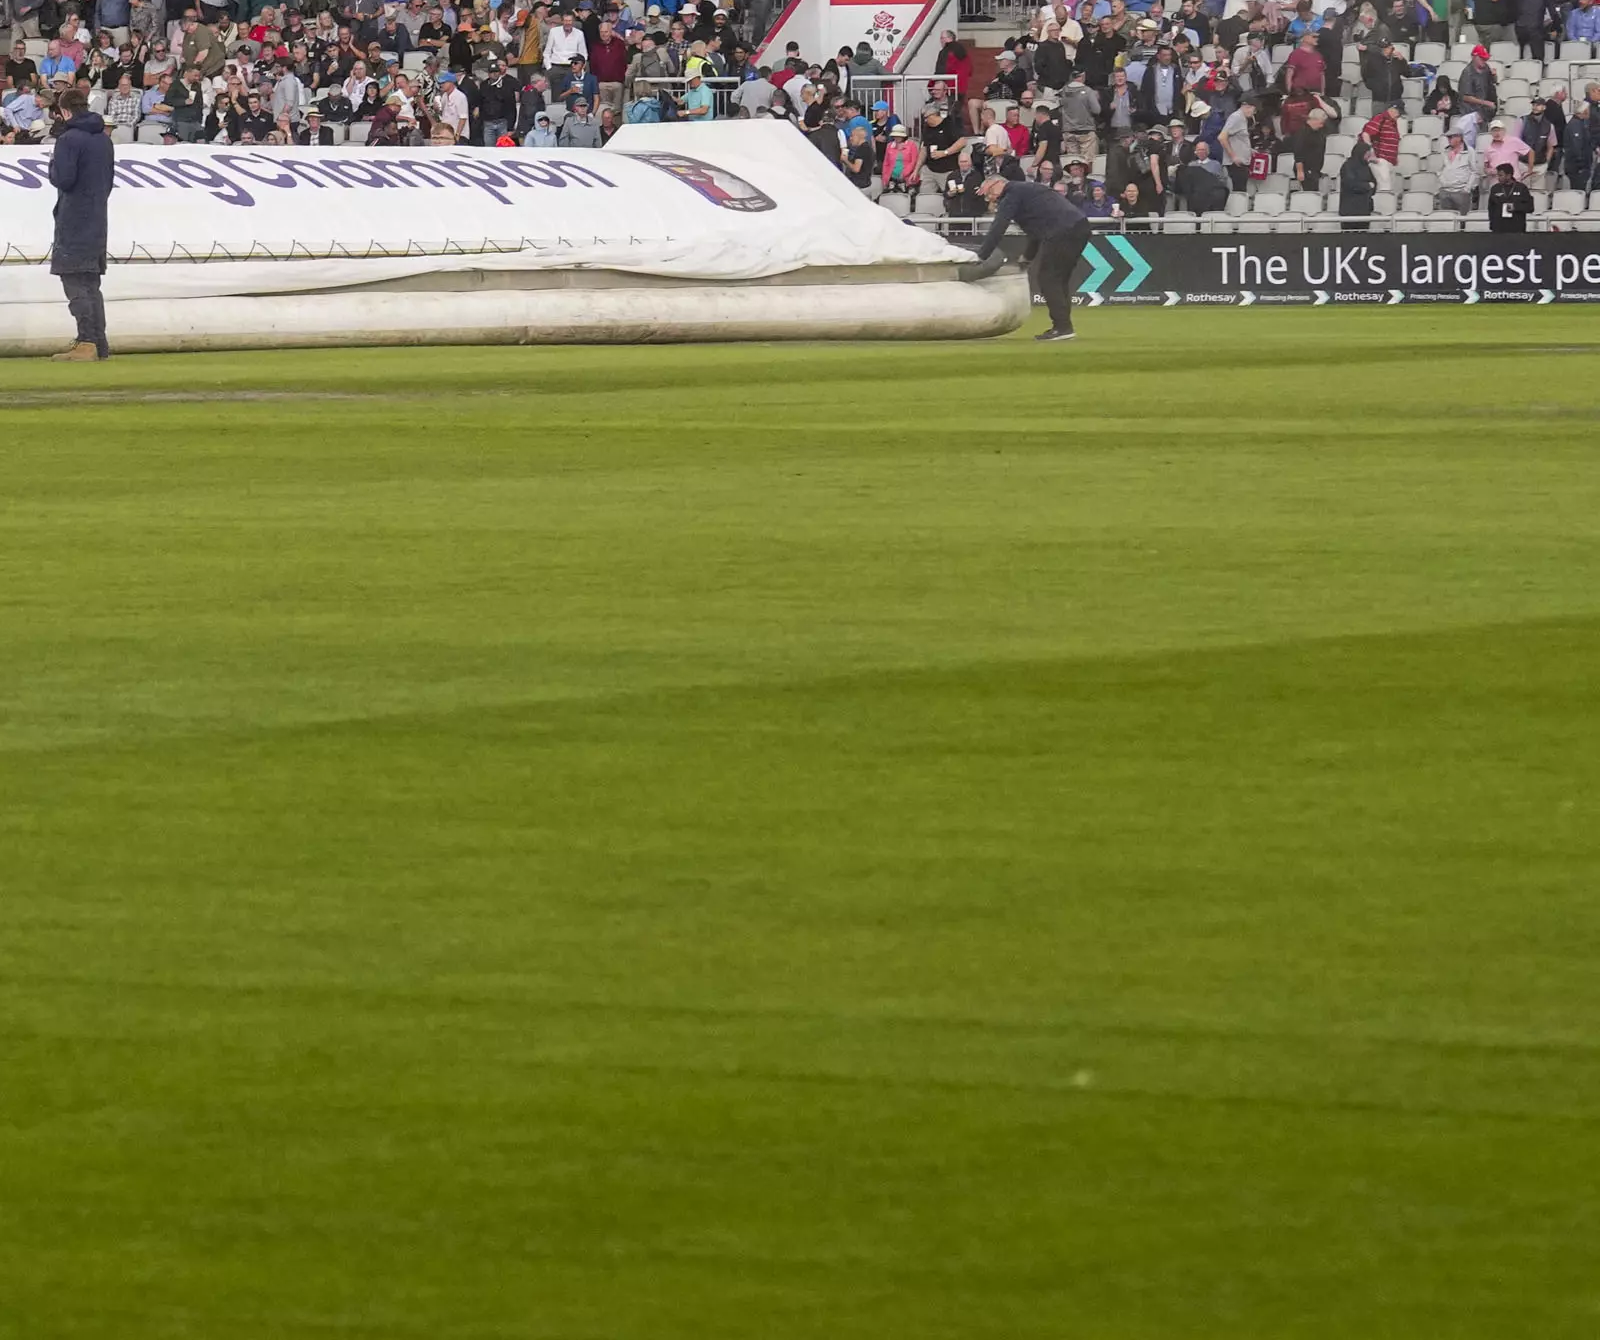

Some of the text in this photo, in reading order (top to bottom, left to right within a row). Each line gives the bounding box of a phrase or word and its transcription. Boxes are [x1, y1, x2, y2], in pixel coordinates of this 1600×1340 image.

[208, 152, 620, 206] Champion
[1212, 245, 1288, 285] The
[1401, 245, 1543, 292] largest
[1186, 293, 1237, 304] Rothesay
[1334, 292, 1384, 303] Rothesay
[1484, 290, 1535, 302] Rothesay
